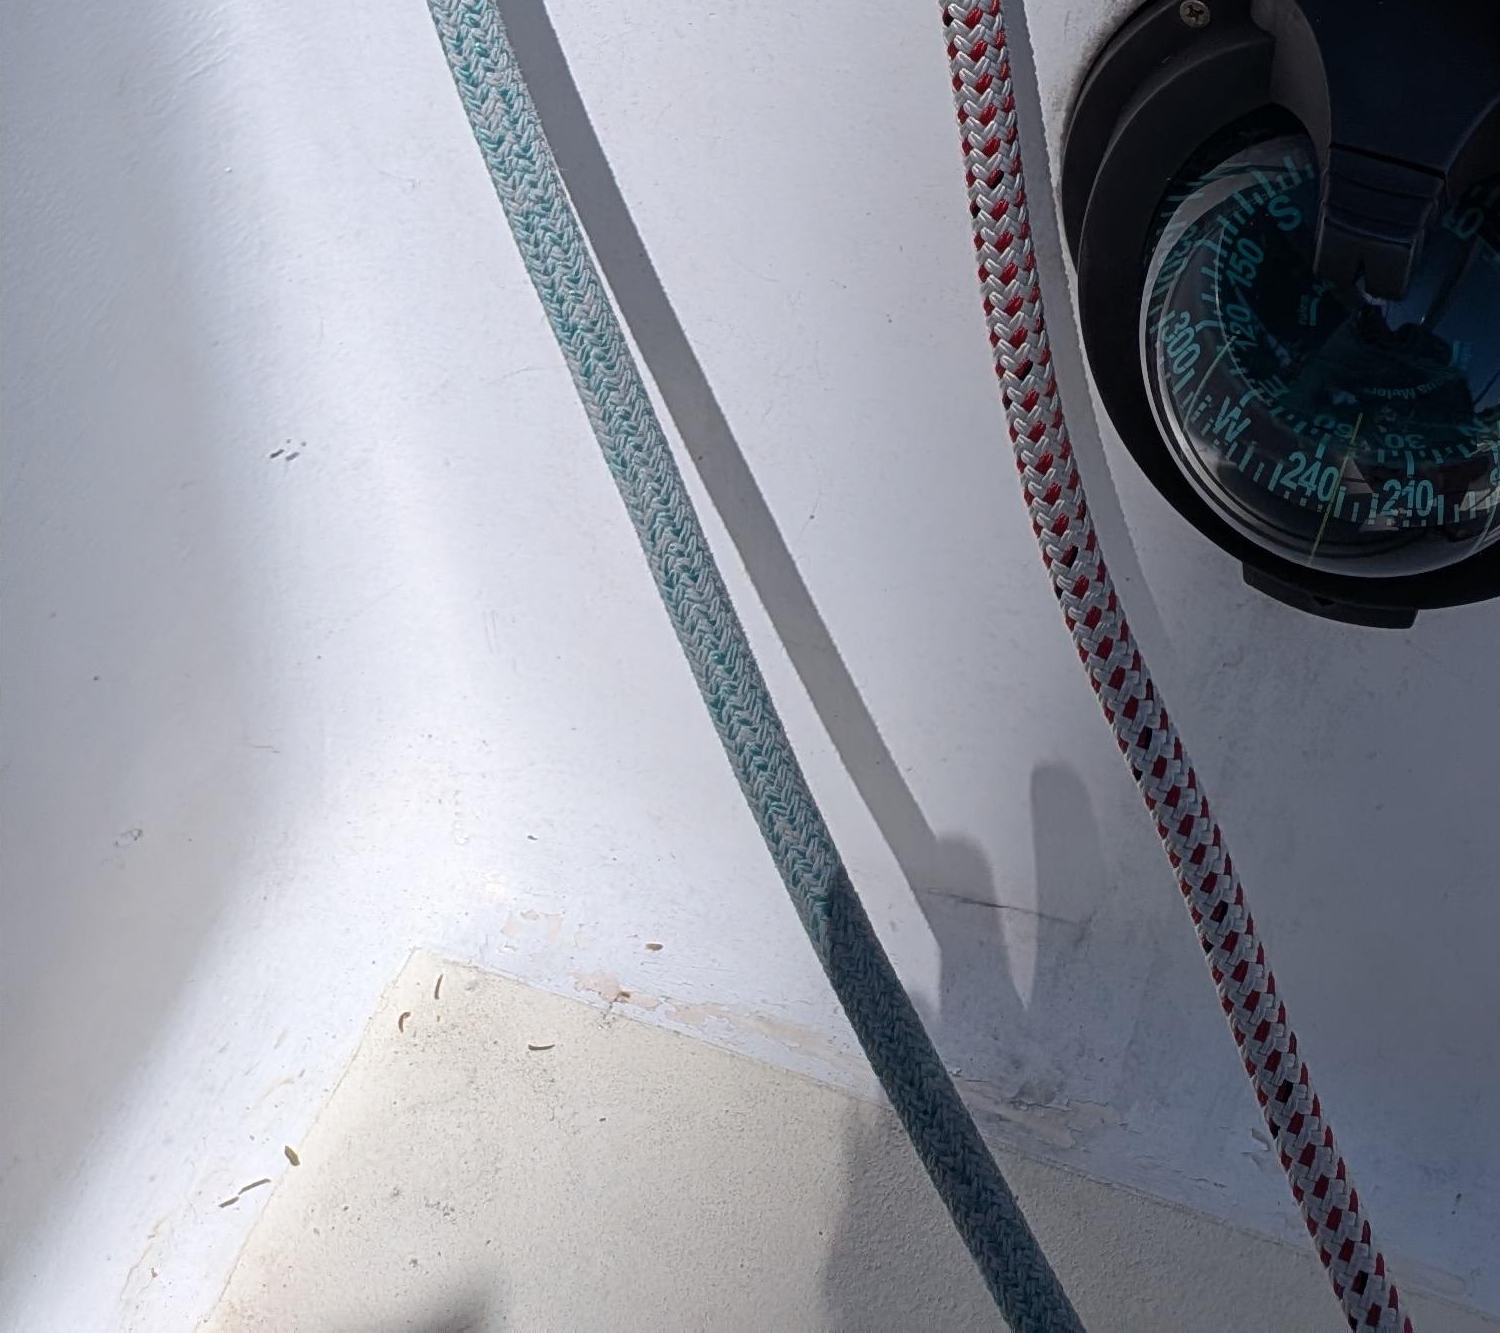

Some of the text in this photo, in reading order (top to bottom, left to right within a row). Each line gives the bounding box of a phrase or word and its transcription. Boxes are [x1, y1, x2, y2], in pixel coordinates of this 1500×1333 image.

[1268, 193, 1303, 232] S
[1226, 236, 1265, 288] 150
[1164, 310, 1202, 375] 300
[1211, 395, 1252, 444] W
[1385, 432, 1428, 450] 30
[1280, 451, 1340, 503] 240
[1382, 478, 1435, 517] 210
